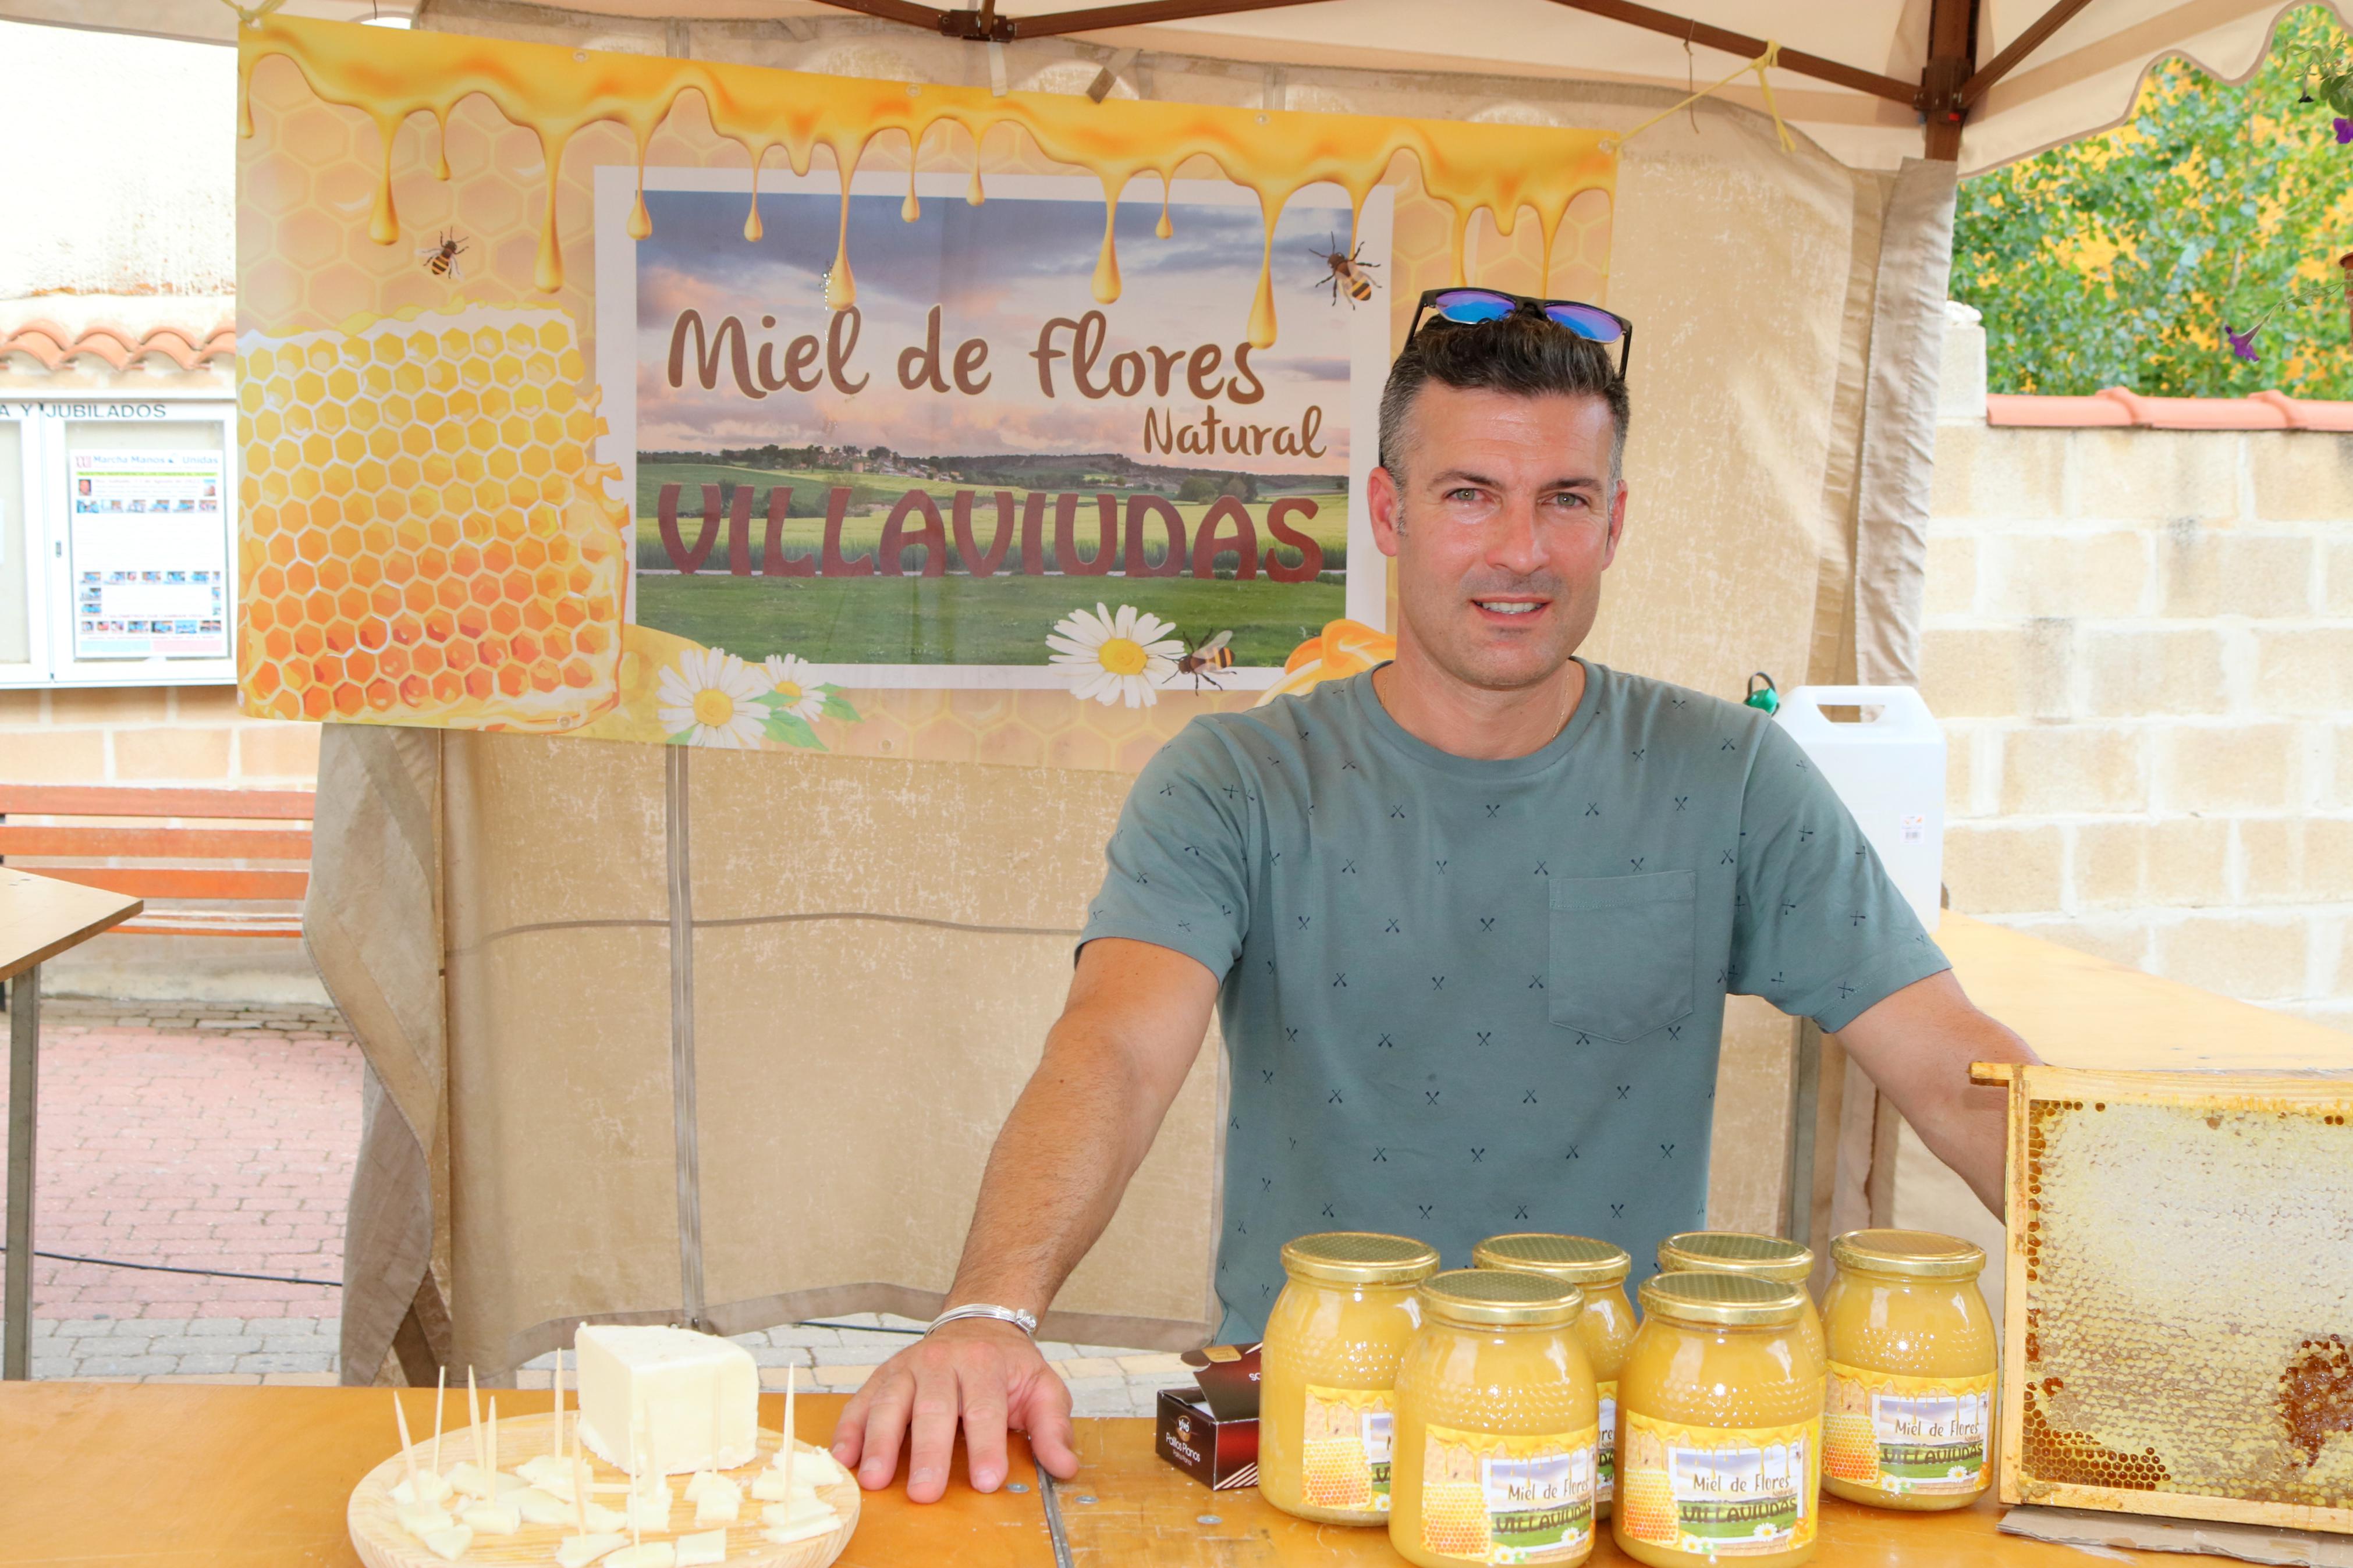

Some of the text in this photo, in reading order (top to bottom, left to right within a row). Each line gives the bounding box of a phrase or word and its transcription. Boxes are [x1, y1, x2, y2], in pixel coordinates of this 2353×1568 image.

[667, 304, 869, 399] Miel
[898, 303, 992, 394] de
[21, 404, 33, 417] Y
[46, 404, 167, 418] JUBILADOS
[1143, 404, 1328, 458] Natural
[94, 456, 127, 464] Marcha
[130, 456, 165, 464] Manos
[183, 456, 218, 464] Unidas
[657, 482, 1324, 582] VILLAVIUDAS
[1895, 1420, 1979, 1437] Miel de Flores
[1182, 1442, 1201, 1462] Planos
[1884, 1443, 1983, 1463] VILLAVIUDAS
[1508, 1485, 1535, 1501] Miel
[1543, 1484, 1557, 1499] de
[1564, 1478, 1588, 1496] Flores
[1693, 1474, 1790, 1492] Miel de Flores
[1683, 1499, 1797, 1523] VILLAVIUDAS
